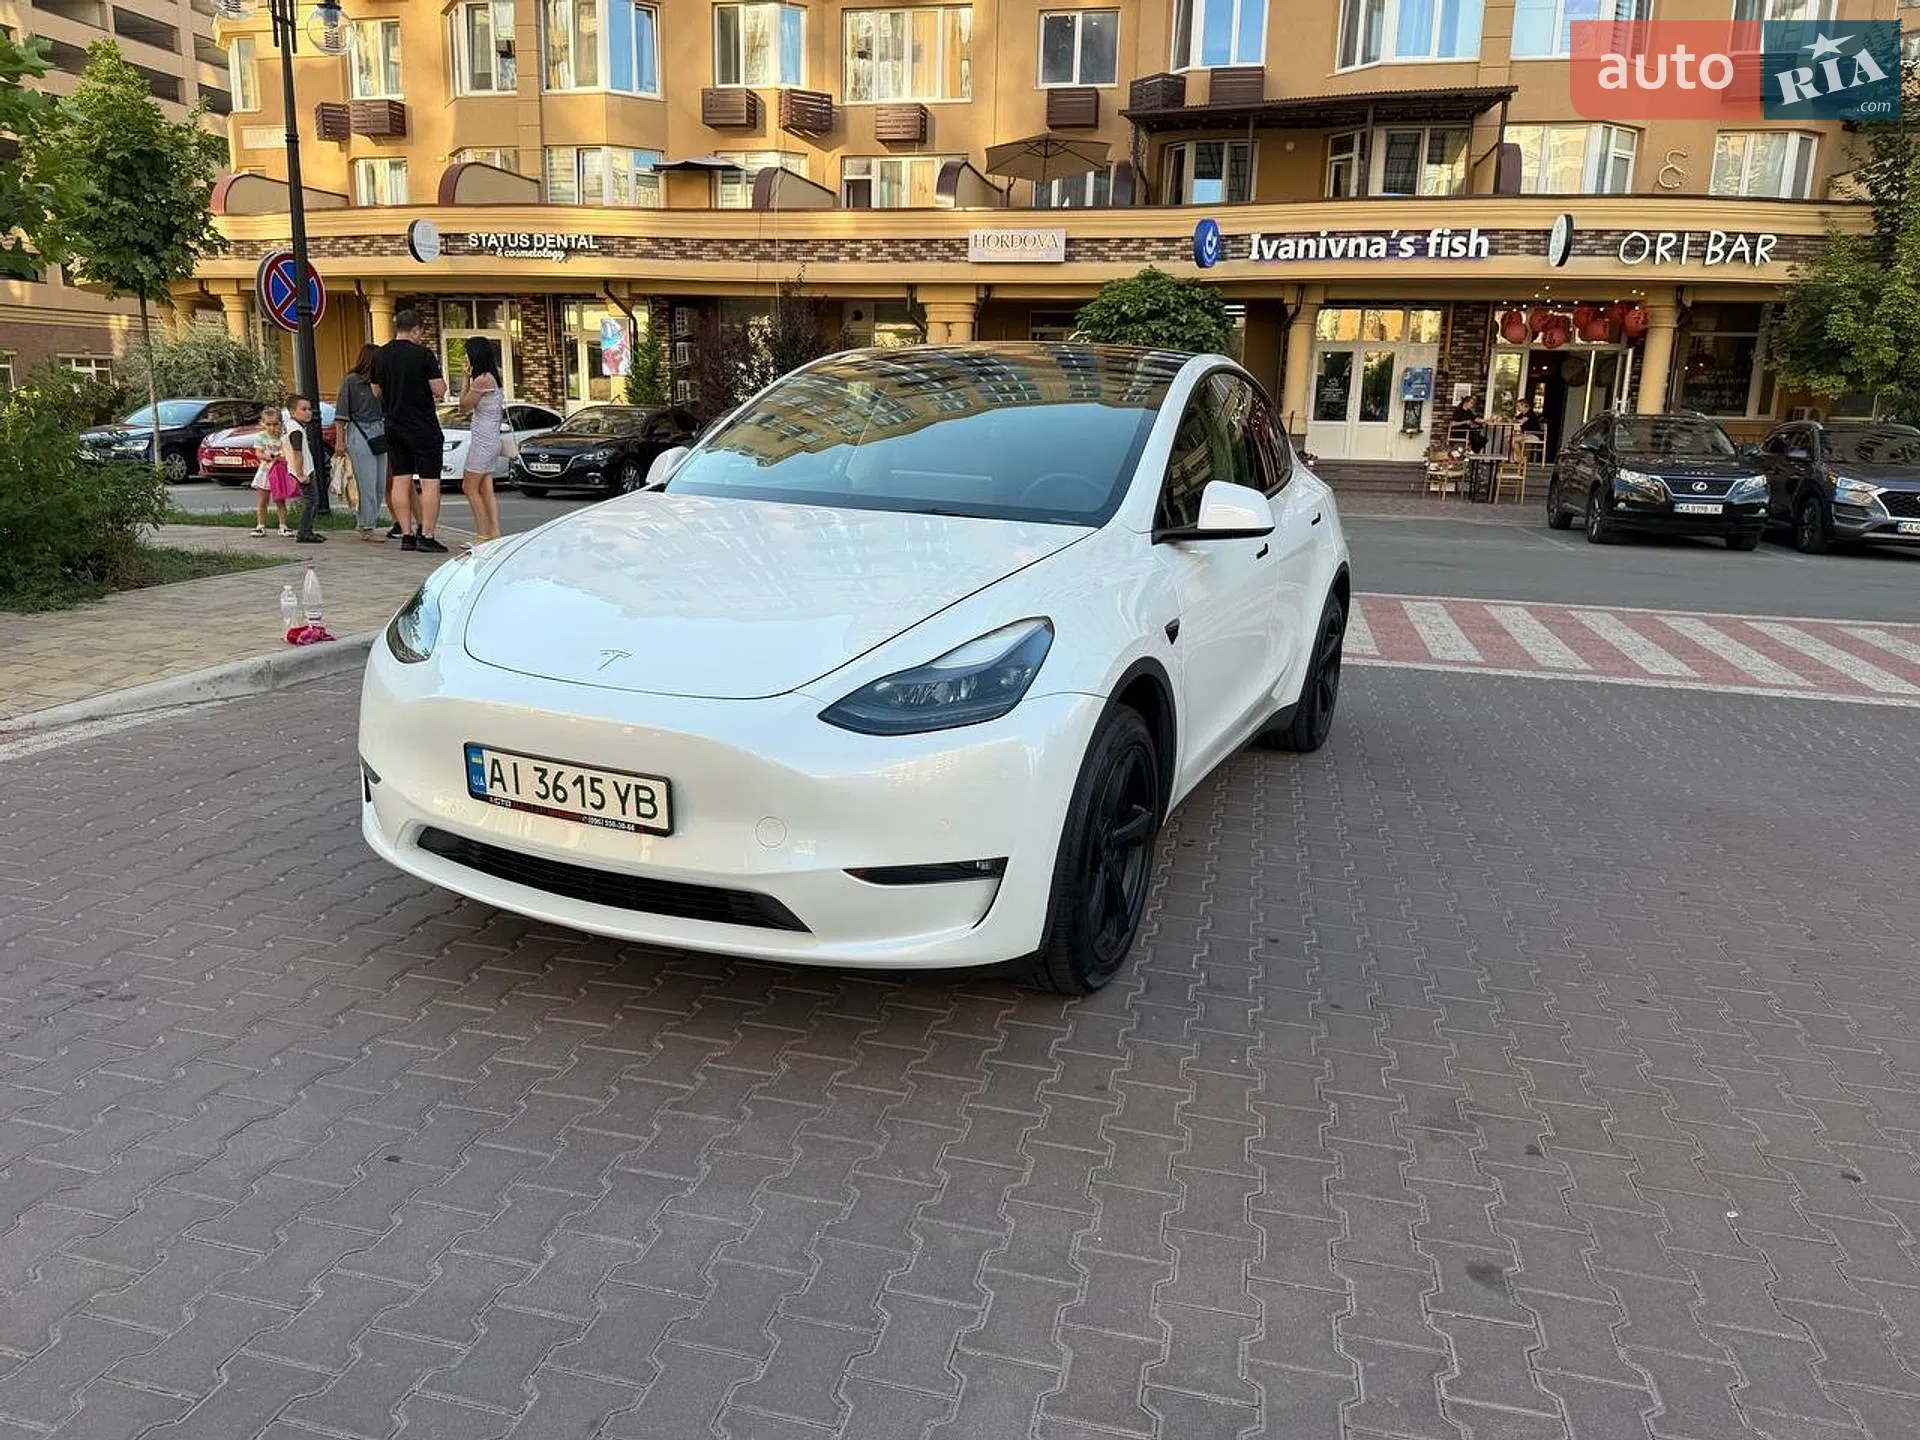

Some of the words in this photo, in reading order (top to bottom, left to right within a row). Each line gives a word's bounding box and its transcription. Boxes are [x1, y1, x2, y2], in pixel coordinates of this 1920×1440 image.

[468, 233, 530, 248] STATUS
[533, 233, 599, 249] DENTAL
[972, 232, 1060, 250] HORDOVA
[1426, 228, 1489, 258] fish
[1619, 231, 1689, 265] ORI
[1704, 230, 1778, 267] BAR
[504, 247, 566, 263] cosmetology
[471, 774, 485, 787] UA
[488, 757, 521, 795] AI
[533, 766, 606, 811] 3615
[612, 780, 659, 820] YB
